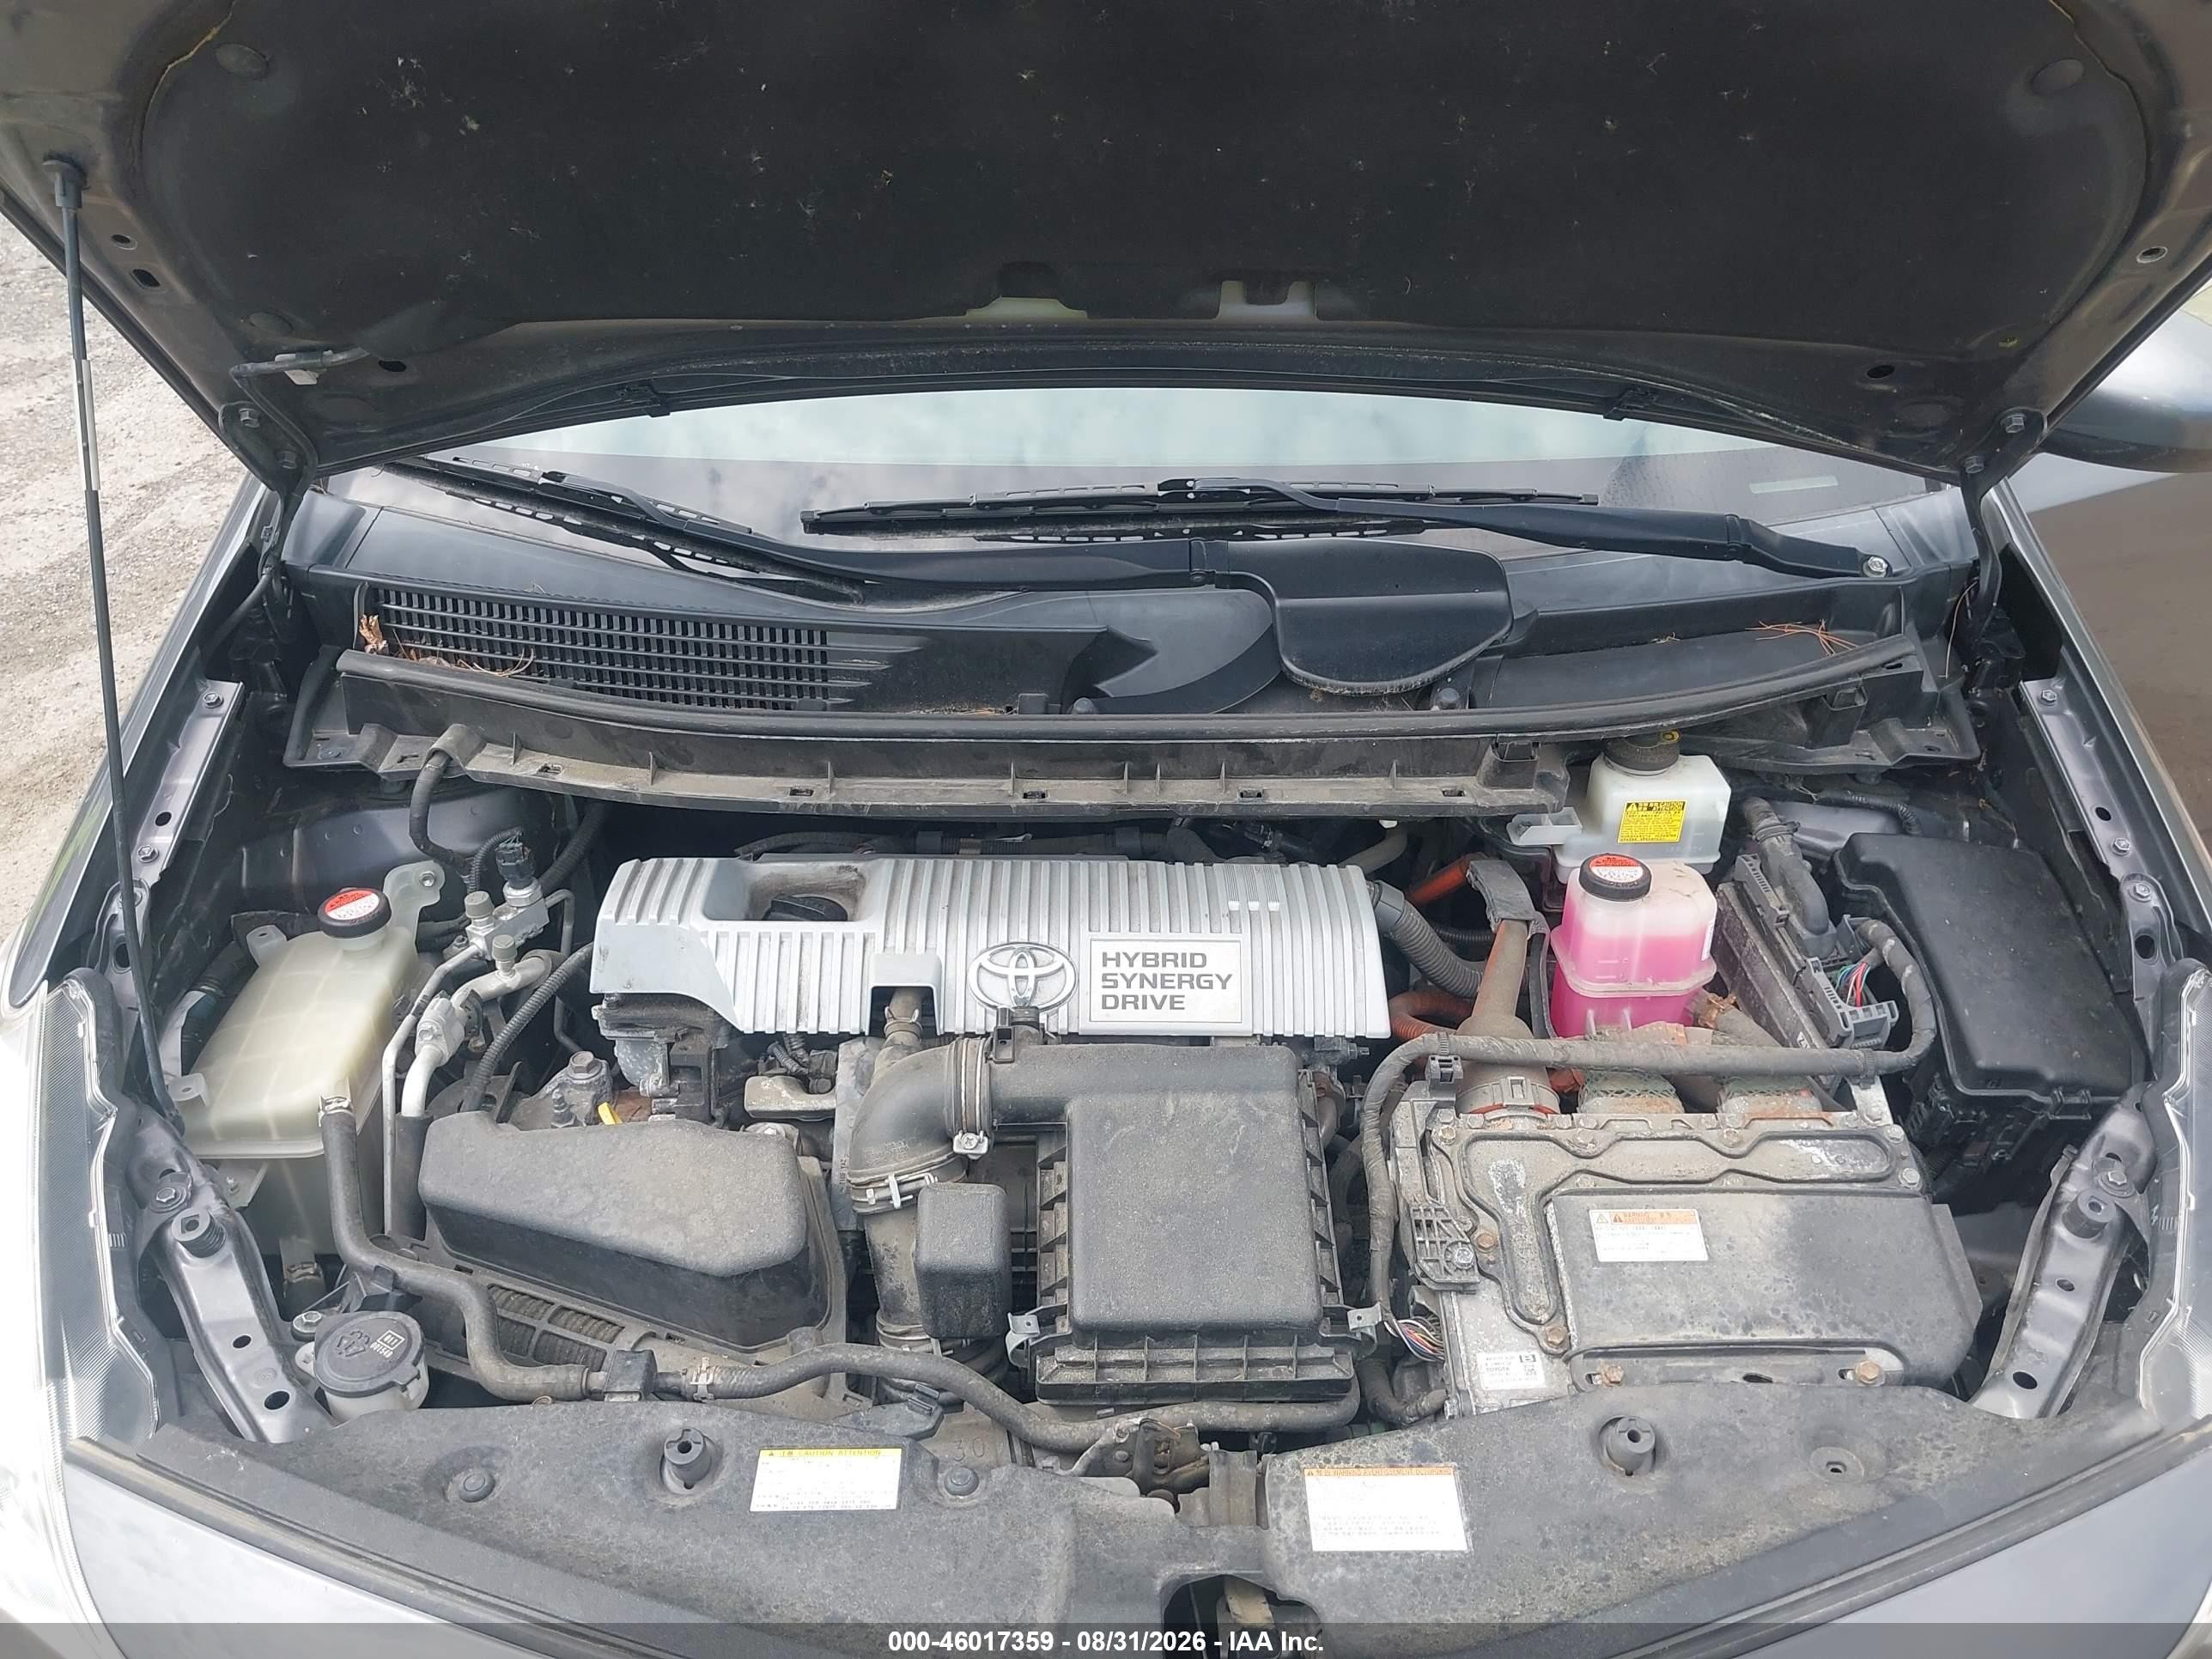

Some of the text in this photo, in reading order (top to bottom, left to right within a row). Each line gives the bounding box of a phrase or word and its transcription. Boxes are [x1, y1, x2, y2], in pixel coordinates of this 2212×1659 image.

[1102, 951, 1207, 968] HYBRID
[1102, 972, 1233, 990] SYNERGY
[1101, 994, 1186, 1010] DRIVE
